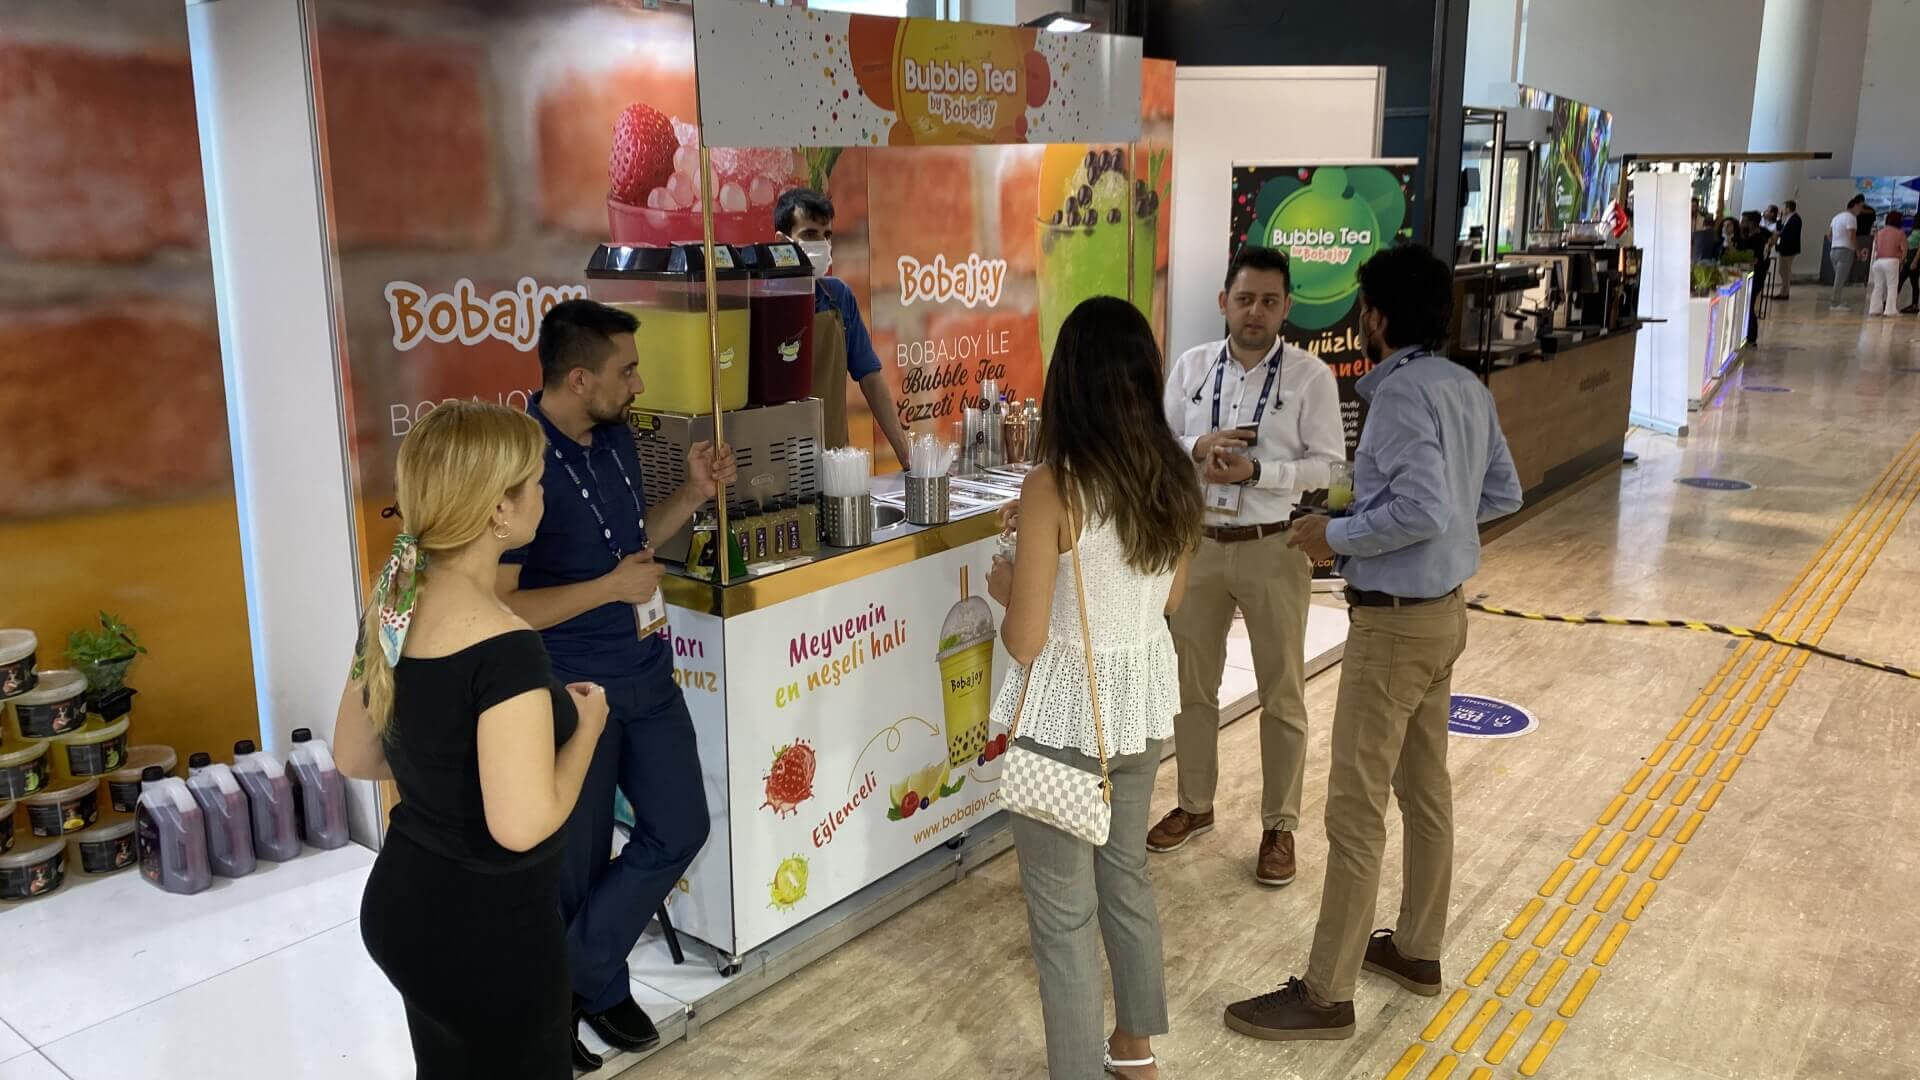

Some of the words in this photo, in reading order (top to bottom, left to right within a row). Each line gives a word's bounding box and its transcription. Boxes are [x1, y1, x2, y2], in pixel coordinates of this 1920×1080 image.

[904, 58, 978, 93] Bubble
[982, 62, 1017, 94] Tea
[929, 94, 943, 111] by
[943, 95, 997, 127] Bobajoy
[1272, 228, 1335, 246] Bubble
[1339, 227, 1372, 245] Tea
[1303, 247, 1350, 264] Bobajoy
[898, 254, 1006, 307] Bobajoy
[897, 333, 982, 367] BOBAJOY
[902, 362, 969, 395] Bubble
[975, 358, 1006, 384] Tea
[789, 602, 887, 668] Meyvenin
[775, 682, 800, 708] en
[807, 639, 865, 691] neşeli
[870, 619, 906, 660] hali
[950, 669, 983, 693] Bobajoy
[812, 770, 877, 849] Eğlenceli
